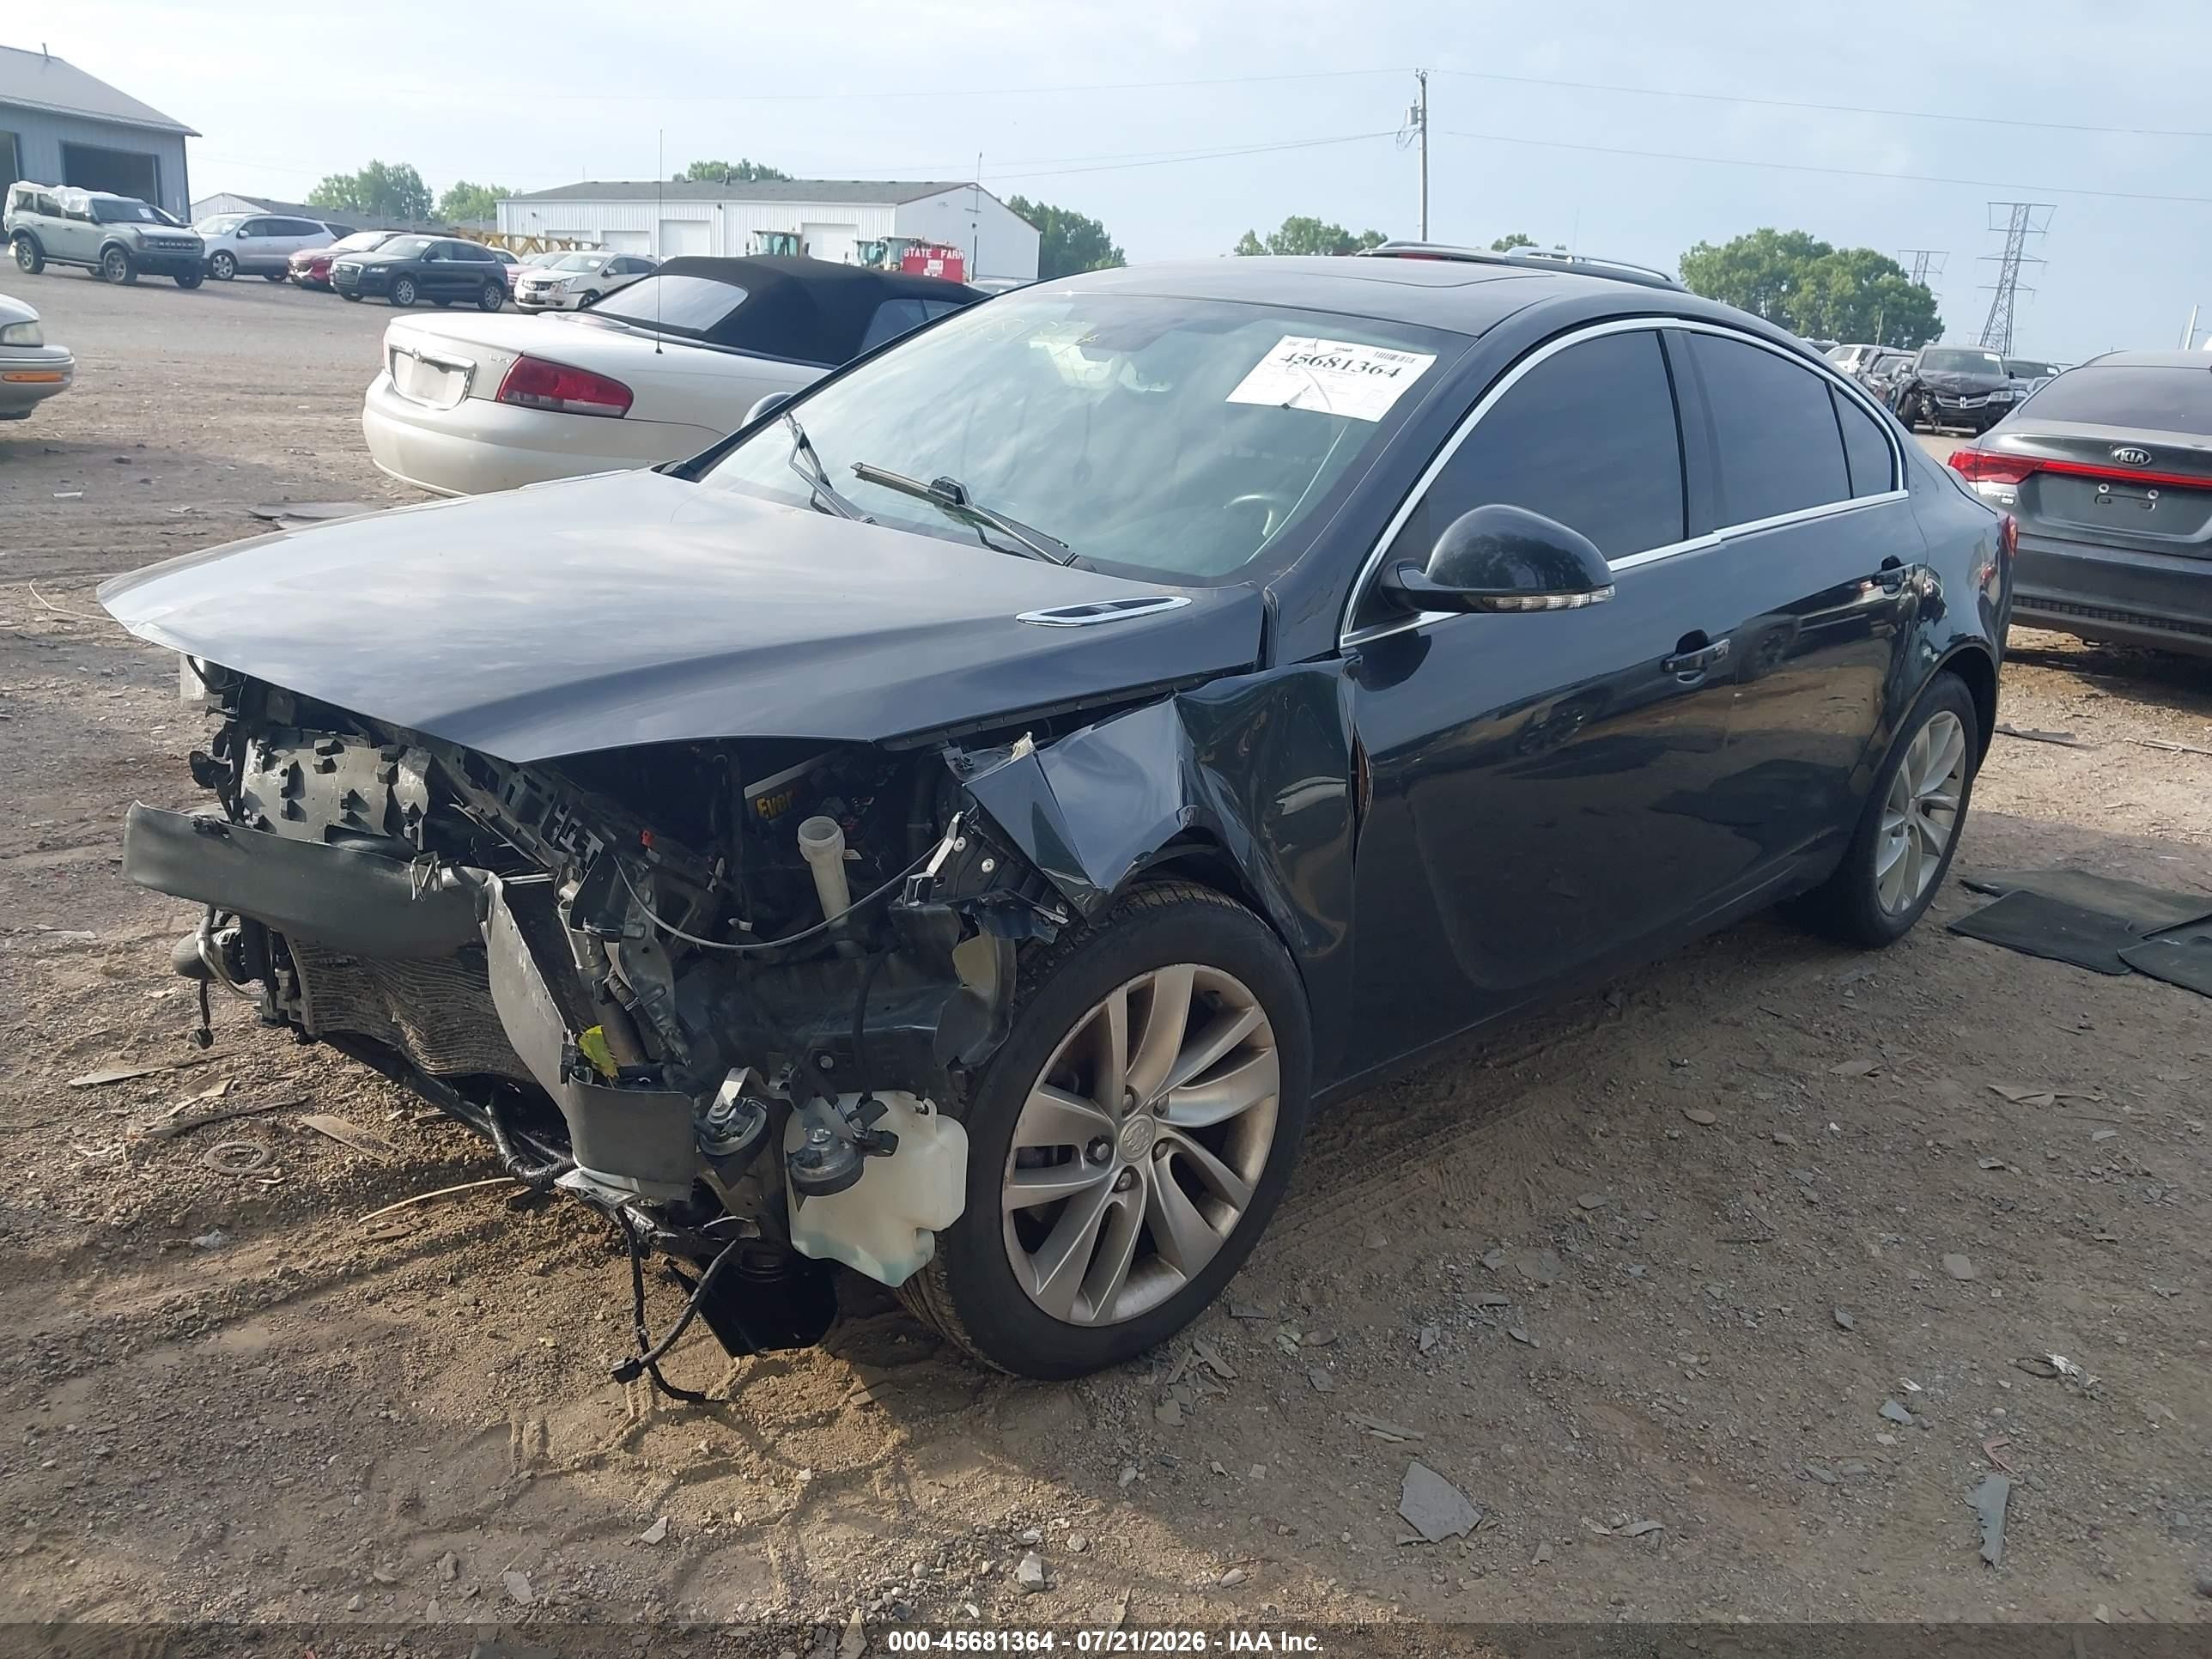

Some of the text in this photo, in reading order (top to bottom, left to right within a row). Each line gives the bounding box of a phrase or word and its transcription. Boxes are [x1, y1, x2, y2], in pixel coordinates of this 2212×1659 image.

[903, 247, 933, 258] STATE
[1279, 352, 1402, 378] 45681364
[2120, 451, 2144, 463] KIA
